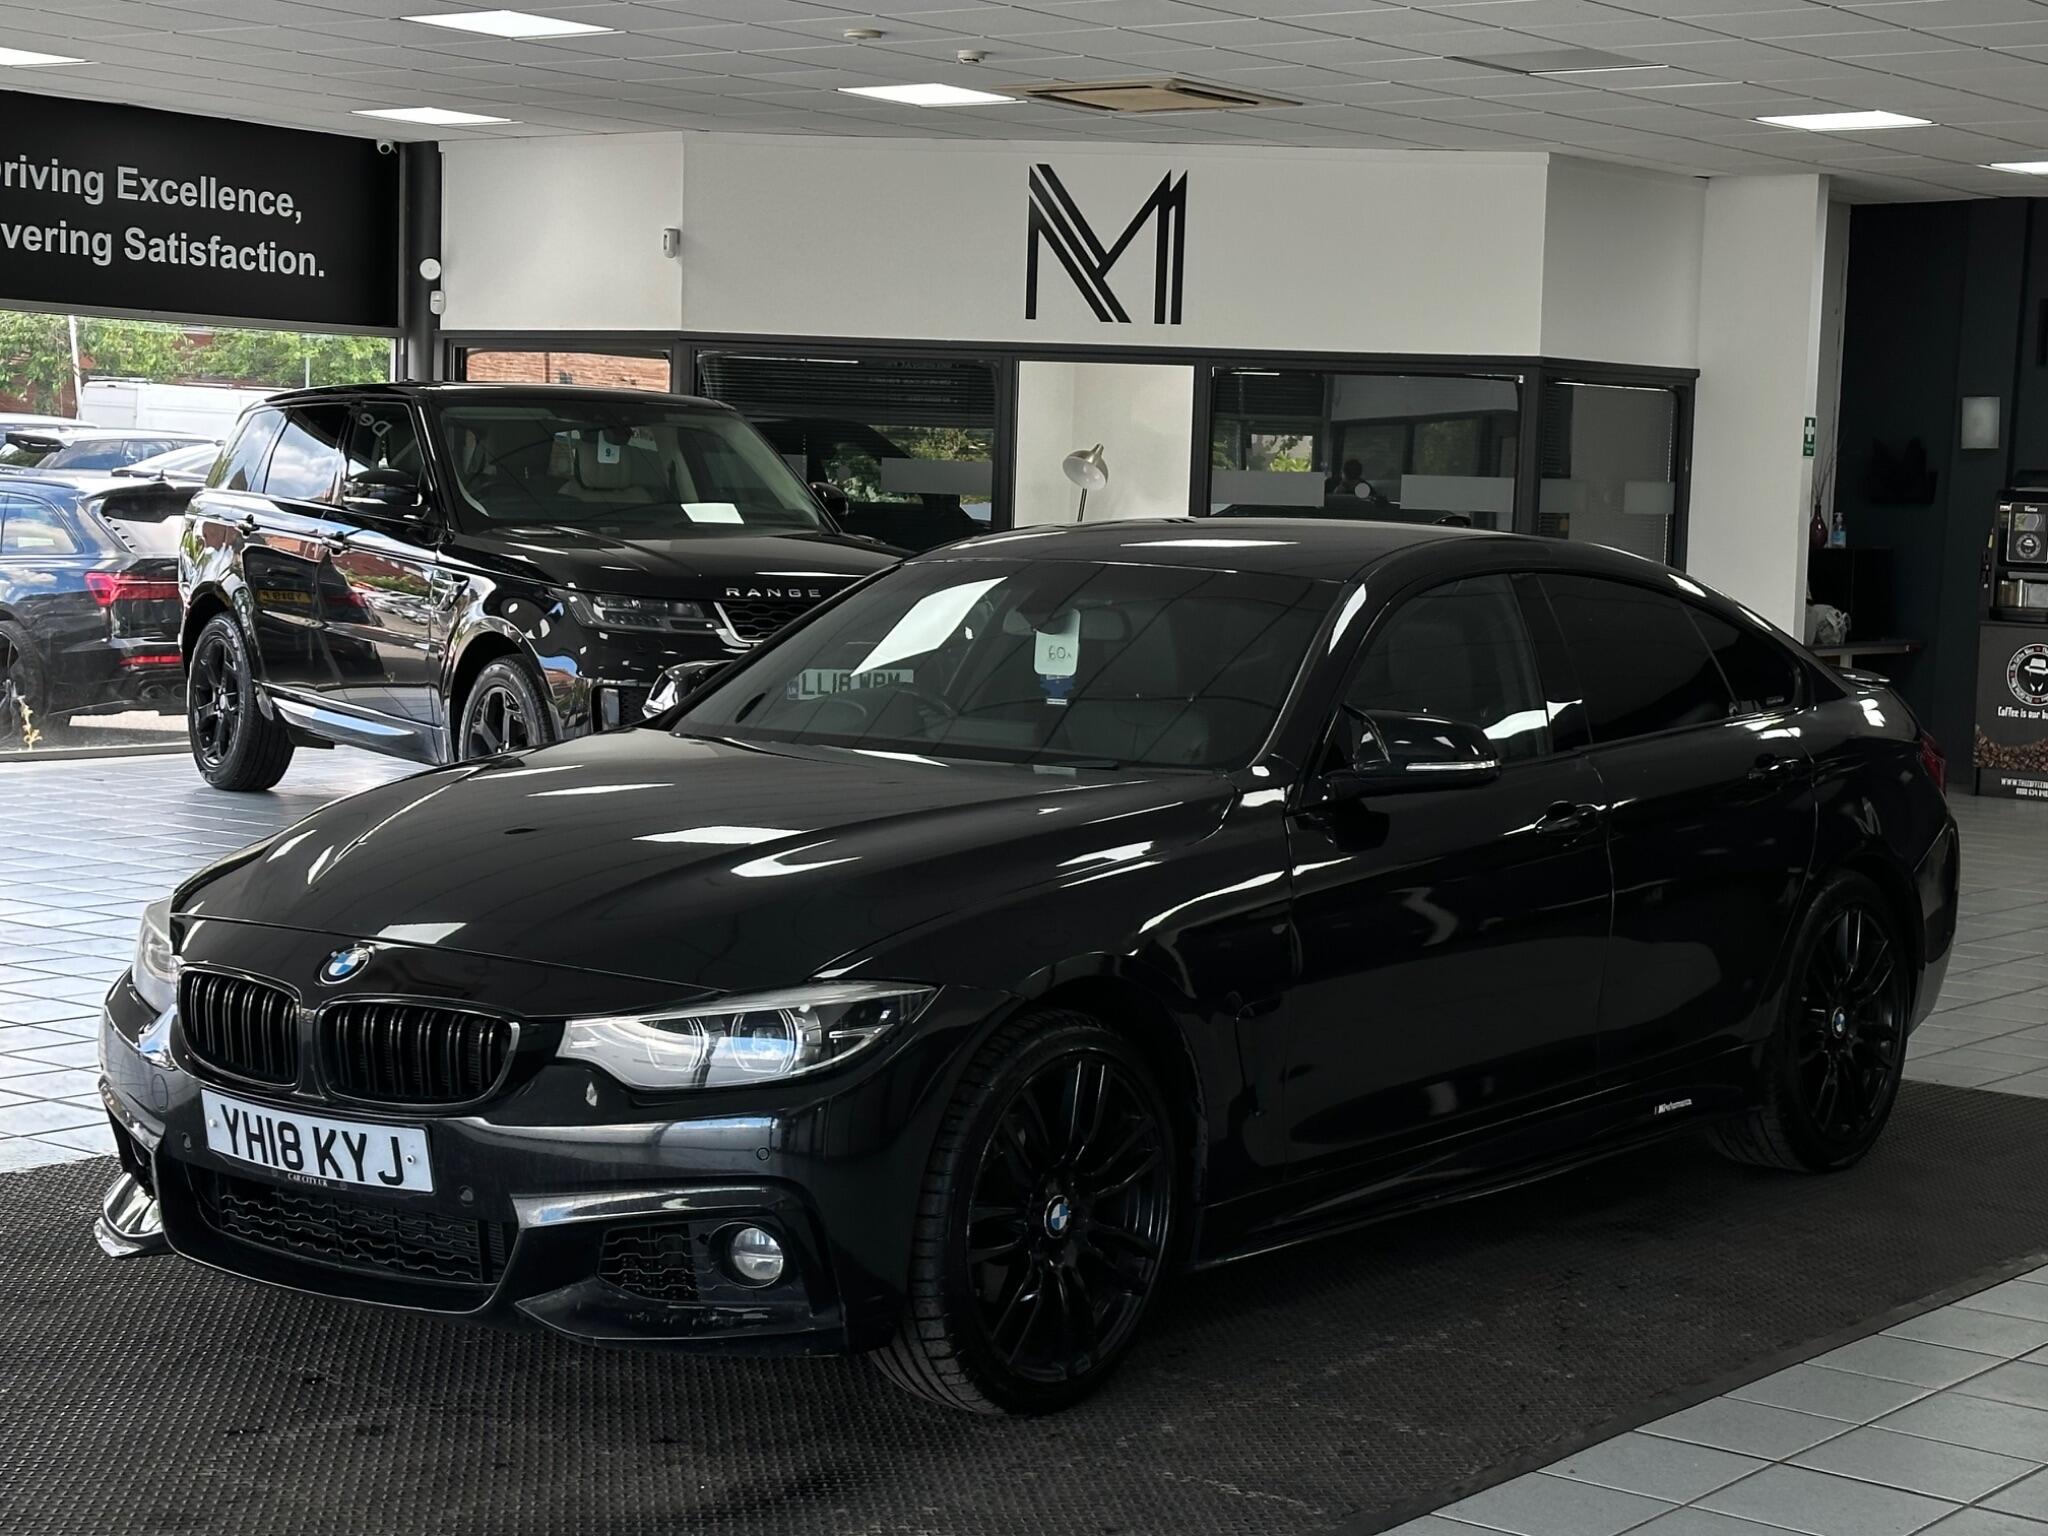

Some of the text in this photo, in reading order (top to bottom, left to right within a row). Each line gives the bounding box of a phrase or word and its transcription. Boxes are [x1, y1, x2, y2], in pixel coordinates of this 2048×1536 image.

[0, 155, 302, 224] riving Excellence,
[124, 226, 326, 277] Satisfaction.
[725, 586, 822, 598] RANGE
[1997, 706, 2020, 718] Coffee
[220, 1103, 404, 1186] YH18 KYJ
